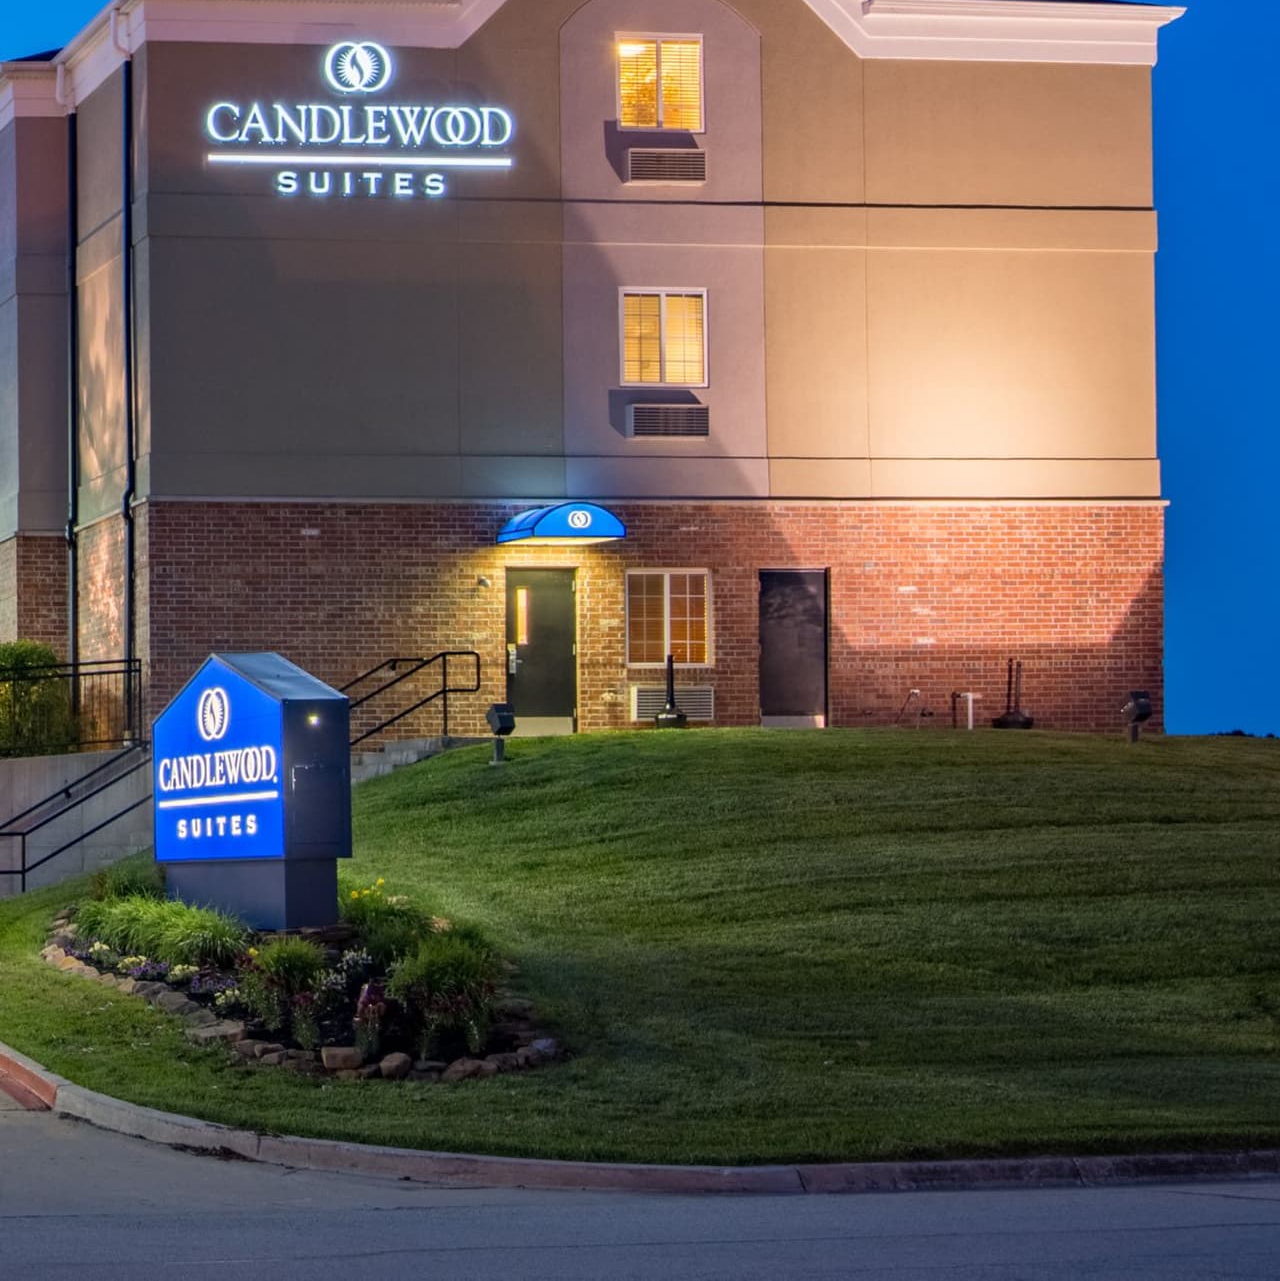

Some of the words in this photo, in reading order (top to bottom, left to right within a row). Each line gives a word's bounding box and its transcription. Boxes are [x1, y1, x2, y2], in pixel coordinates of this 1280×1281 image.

[206, 102, 513, 146] CANDLEWOOD
[277, 171, 446, 196] SUITES
[158, 745, 276, 792] CANDLEWOOD
[176, 814, 258, 839] SUITES
